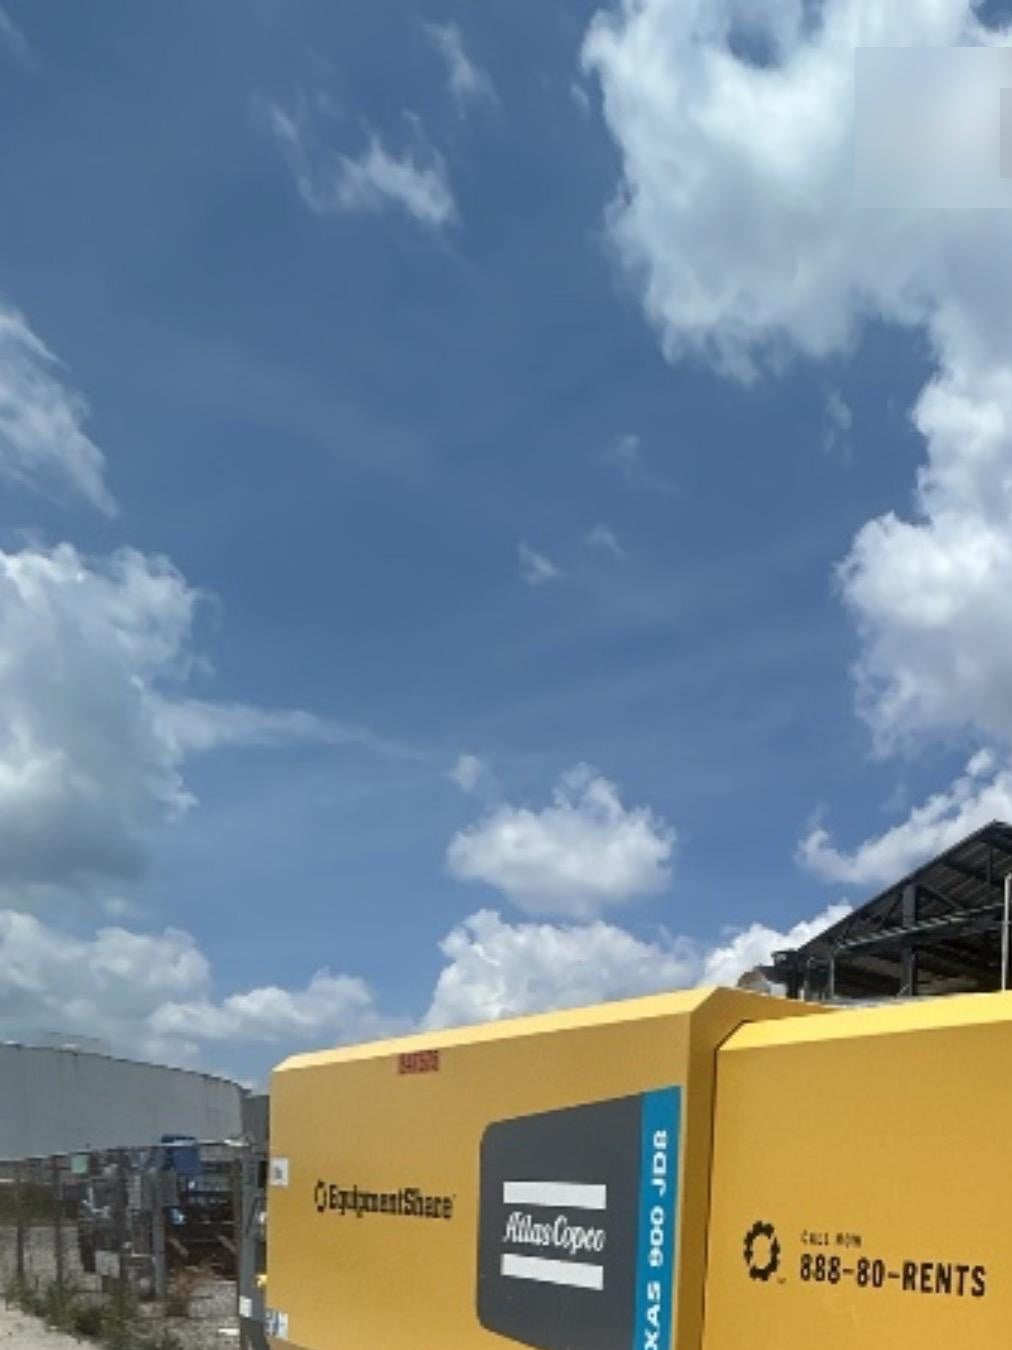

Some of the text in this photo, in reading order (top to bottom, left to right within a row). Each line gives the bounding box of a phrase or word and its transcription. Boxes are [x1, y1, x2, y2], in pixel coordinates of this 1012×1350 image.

[329, 1184, 454, 1220] EquipmentShare
[648, 1206, 665, 1268] 900
[799, 1253, 987, 1298] 888-80-RENTS
